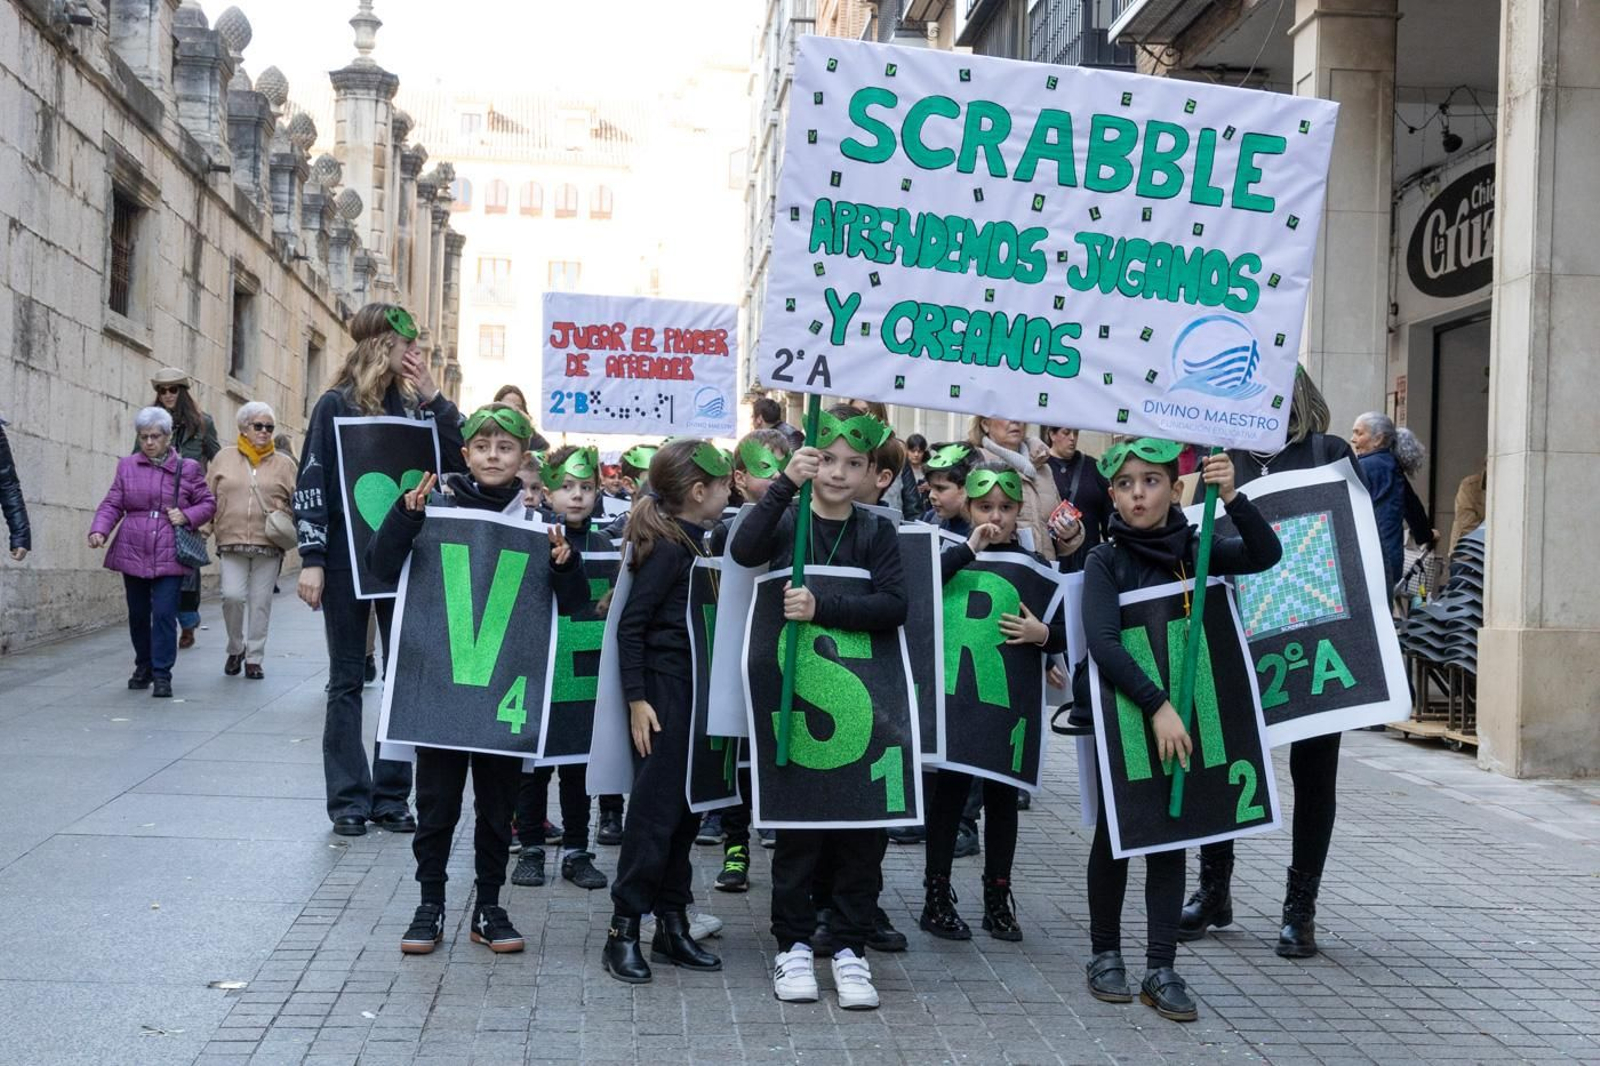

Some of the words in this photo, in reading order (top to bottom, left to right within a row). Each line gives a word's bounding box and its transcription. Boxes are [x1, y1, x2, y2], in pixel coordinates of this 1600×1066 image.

[840, 87, 1287, 212] SCRABBLE
[809, 198, 1048, 284] APRENDEMOS
[1067, 231, 1263, 314] JUGAMOS
[1434, 236, 1445, 254] La
[550, 321, 627, 352] JUGAR
[631, 327, 658, 353] EL
[664, 327, 729, 357] PLACER
[825, 288, 862, 346] Y
[881, 300, 1083, 378] CREAMOS
[565, 353, 590, 377] DE
[605, 354, 694, 381] APRENDER
[1143, 400, 1199, 419] DIVINO
[1204, 409, 1279, 431] MAESTRO
[440, 543, 530, 687] V
[943, 569, 1020, 709] R
[496, 676, 527, 734] 4
[771, 621, 873, 770] S
[1009, 717, 1027, 773] 1
[871, 746, 905, 812] 1
[1228, 759, 1265, 823] 2
